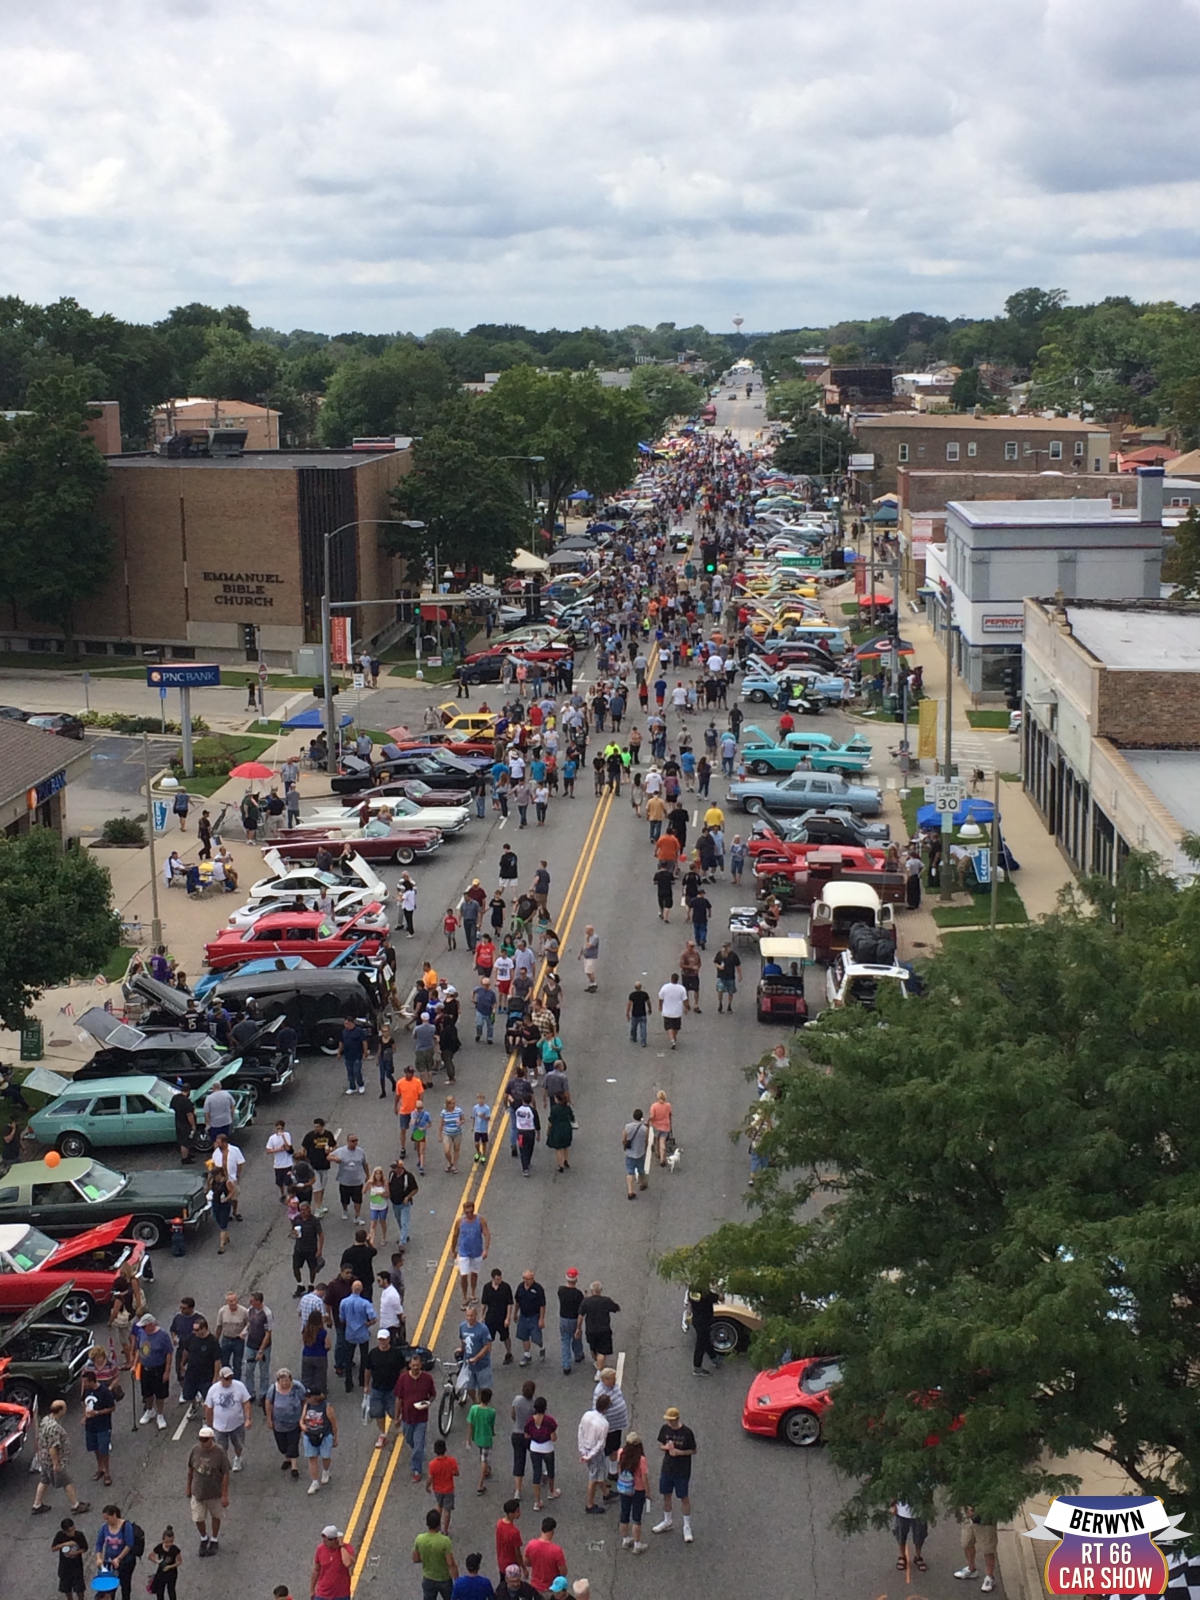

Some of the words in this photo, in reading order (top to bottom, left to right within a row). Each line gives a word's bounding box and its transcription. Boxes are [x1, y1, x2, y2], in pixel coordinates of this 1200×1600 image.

[202, 572, 285, 583] EMMANUEL
[222, 584, 266, 595] BIBLE
[214, 595, 274, 607] CHURCH
[162, 671, 186, 682] PNC
[185, 671, 215, 681] BANK
[937, 798, 958, 810] 30
